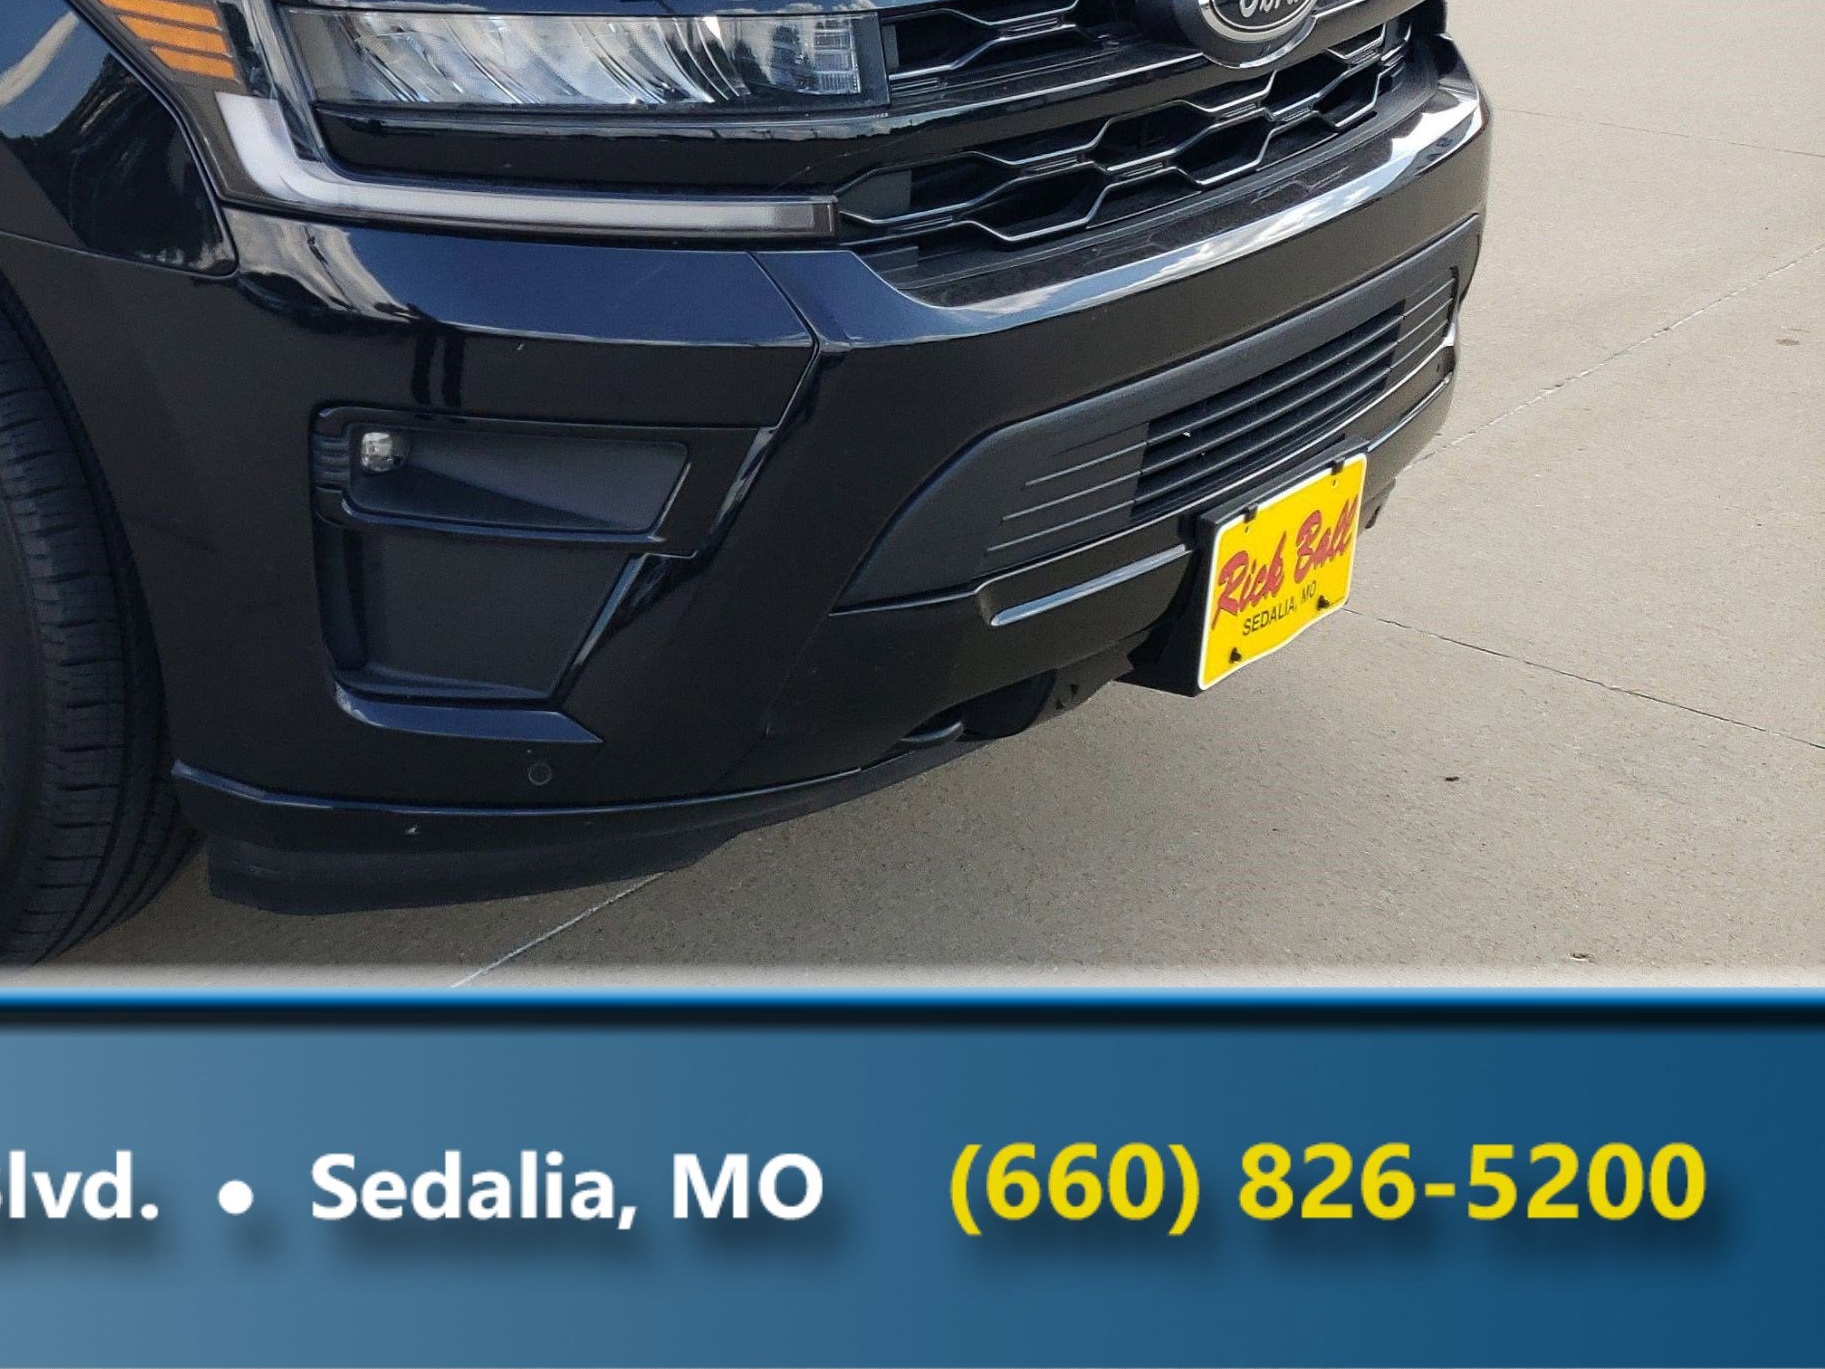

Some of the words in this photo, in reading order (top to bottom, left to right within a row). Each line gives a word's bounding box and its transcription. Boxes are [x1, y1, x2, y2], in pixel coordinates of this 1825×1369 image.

[1211, 530, 1288, 631] Rick
[1293, 494, 1359, 584] Ball
[1242, 595, 1297, 636] SEDALIA,
[1300, 581, 1317, 606] MO
